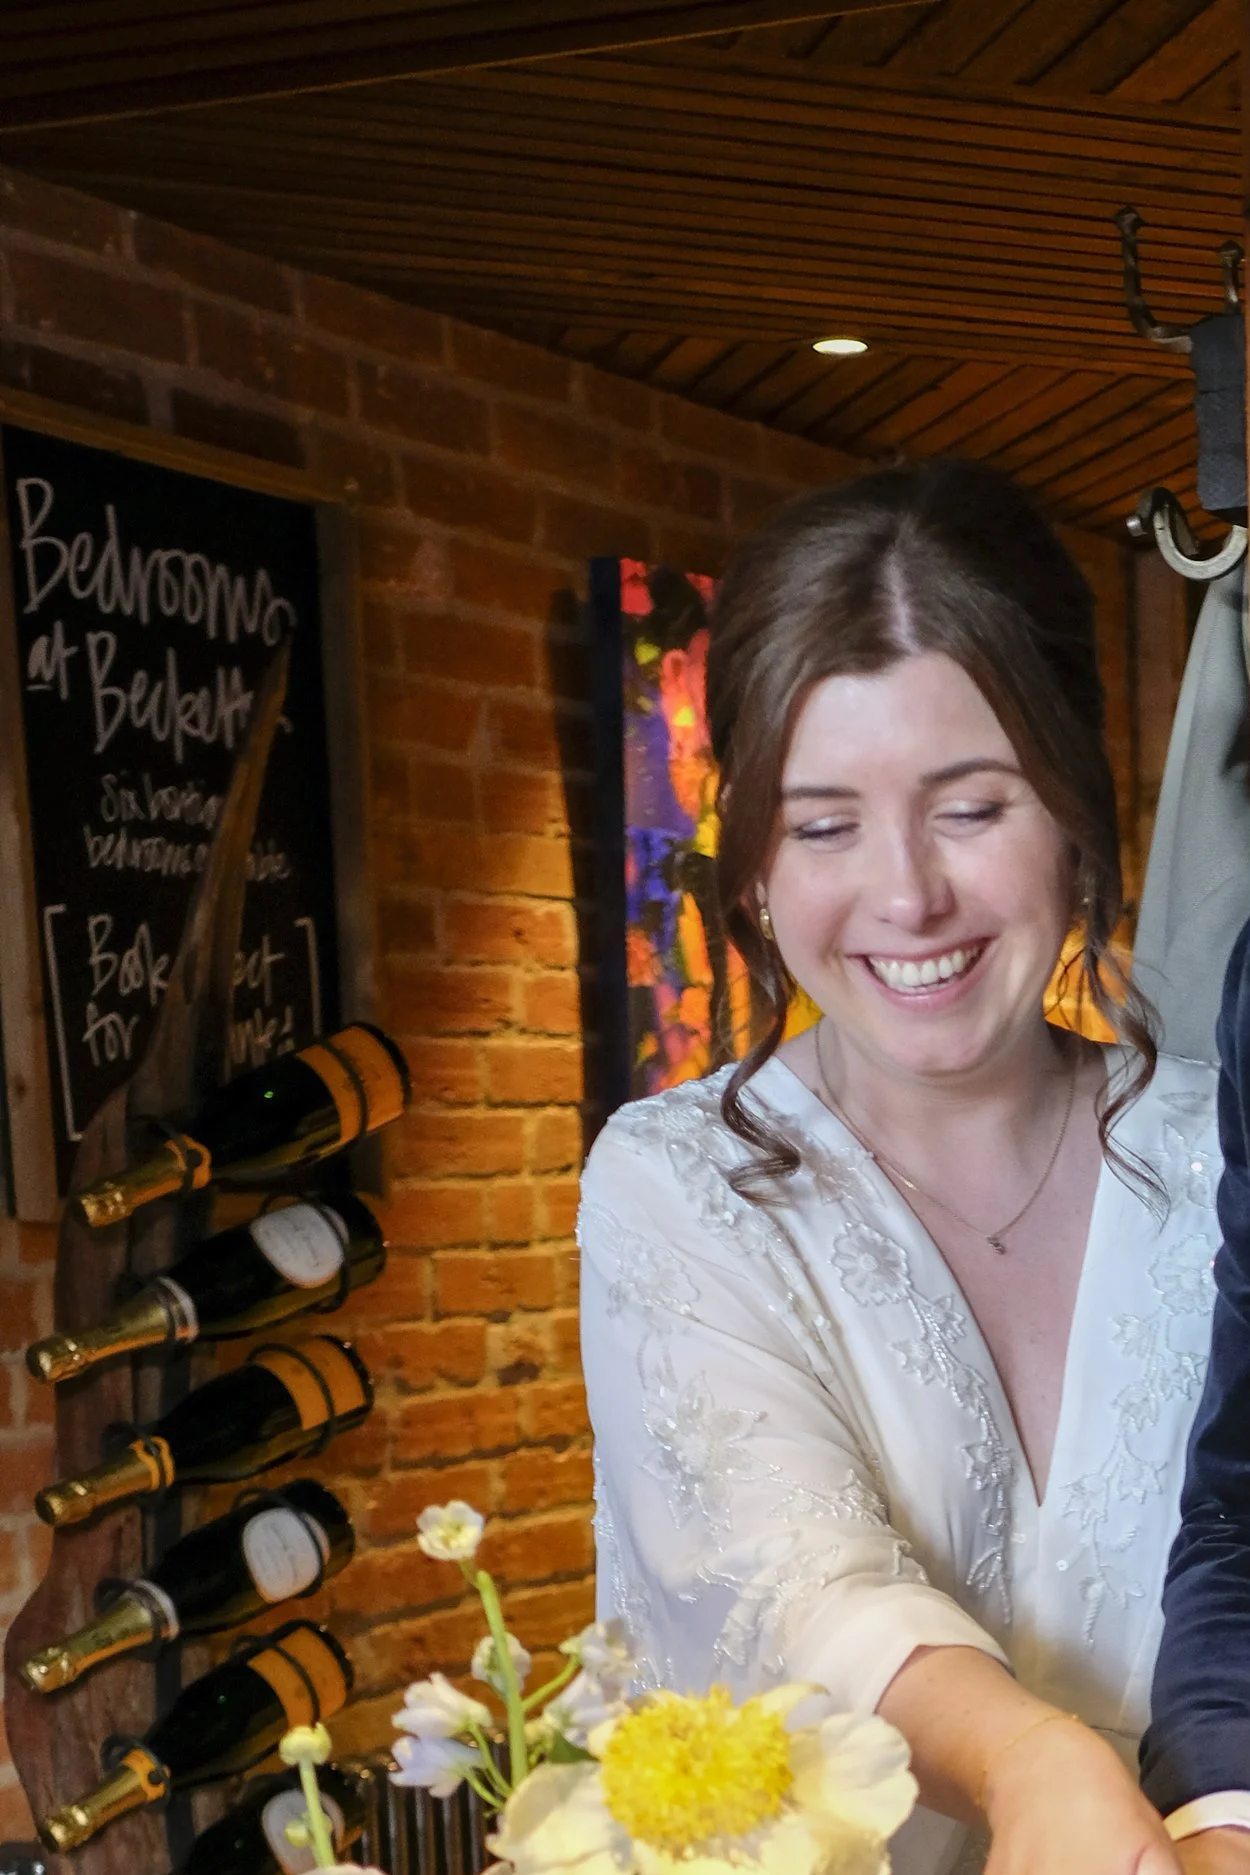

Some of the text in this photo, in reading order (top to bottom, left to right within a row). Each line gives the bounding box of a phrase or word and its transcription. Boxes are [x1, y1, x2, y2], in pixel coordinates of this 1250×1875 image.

[16, 477, 297, 647] Bedrooms
[27, 619, 79, 700] at
[81, 1000, 140, 1067] for
